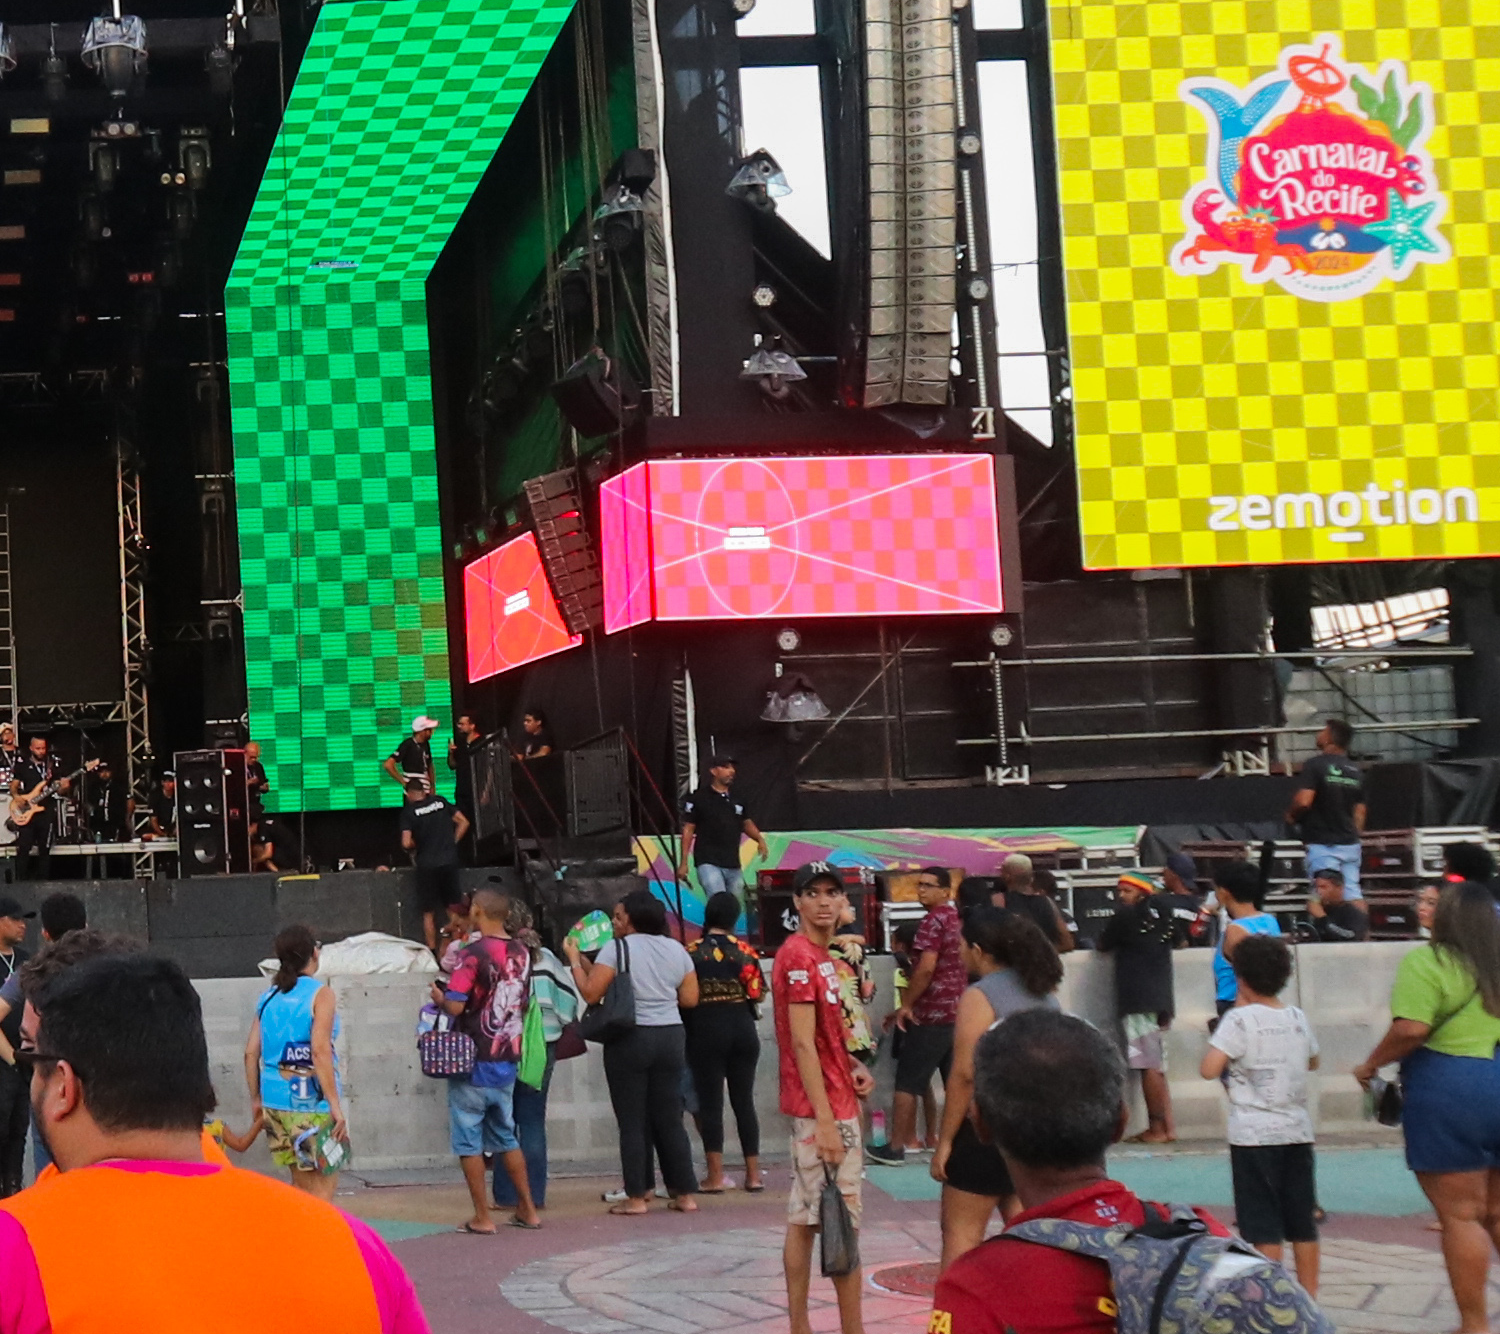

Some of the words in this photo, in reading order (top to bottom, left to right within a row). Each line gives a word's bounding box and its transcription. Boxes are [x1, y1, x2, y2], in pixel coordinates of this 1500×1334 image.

[1311, 169, 1335, 188] do
[1258, 177, 1378, 220] Recife
[1208, 479, 1479, 542] zemotion
[286, 1047, 311, 1061] ACS
